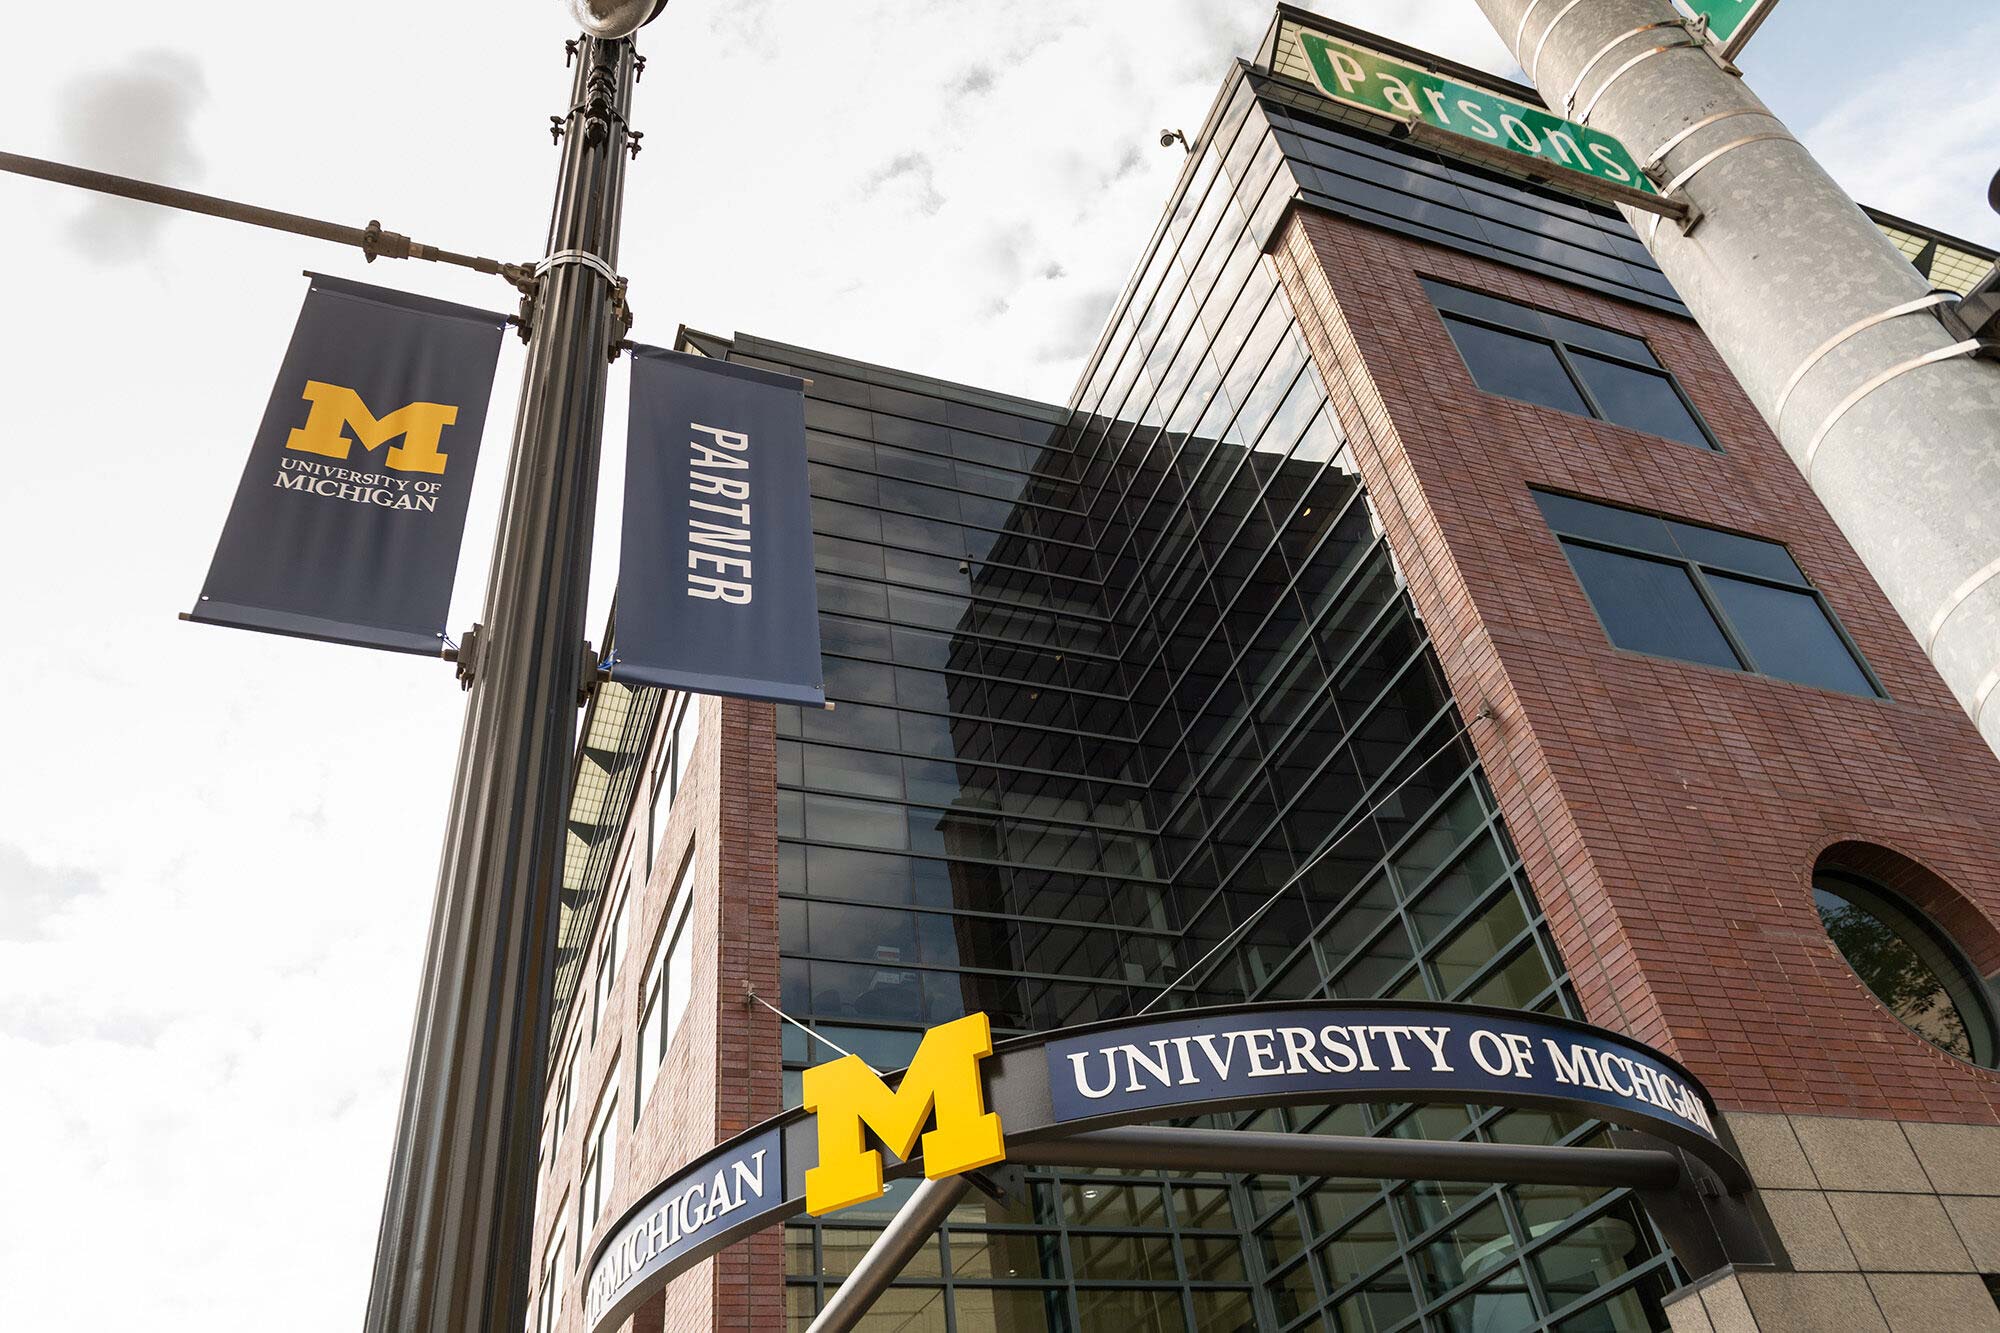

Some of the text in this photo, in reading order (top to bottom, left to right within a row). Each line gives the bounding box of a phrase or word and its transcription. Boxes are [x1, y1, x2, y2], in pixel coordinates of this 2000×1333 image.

[1324, 47, 1631, 182] Parsons
[280, 456, 442, 495] UNIVERSITY OF
[285, 380, 459, 475] M
[272, 470, 439, 513] MICHIGAN
[687, 422, 753, 606] PARTNER
[803, 1011, 1006, 1218] M
[1066, 1024, 1718, 1140] UNIVERSITY OF MICHIGAN
[607, 1148, 767, 1302] MICHIGAN
